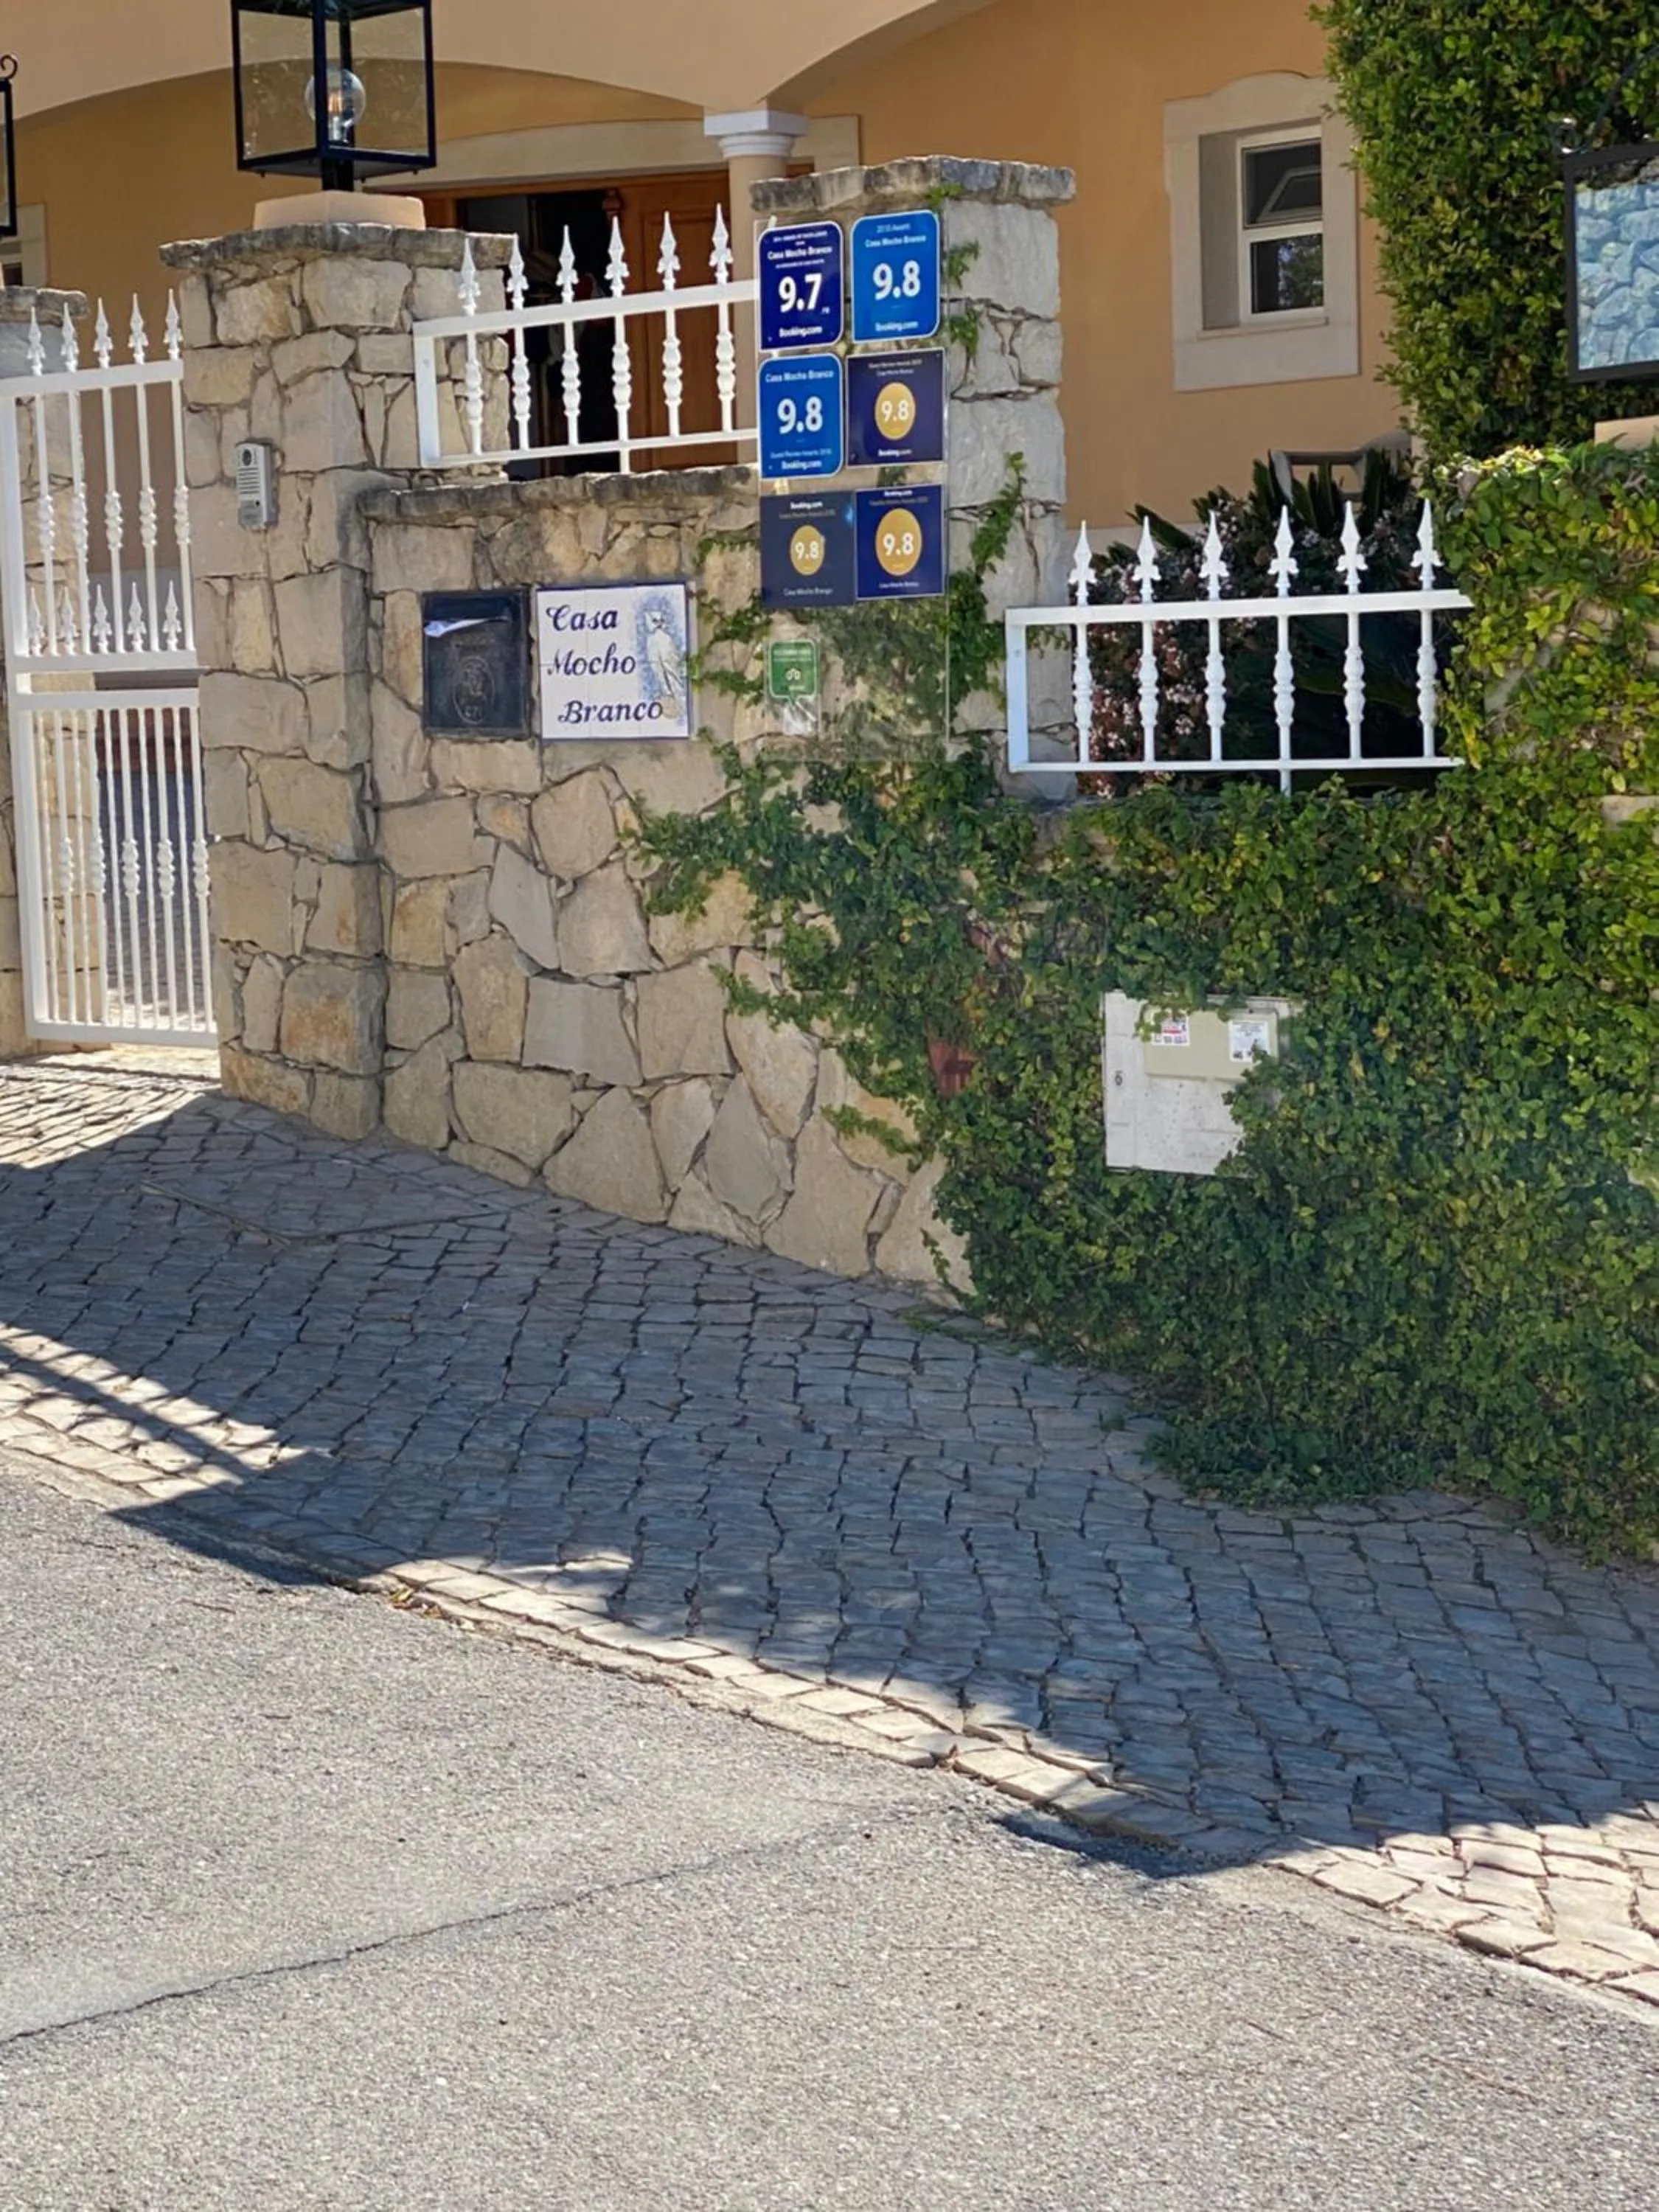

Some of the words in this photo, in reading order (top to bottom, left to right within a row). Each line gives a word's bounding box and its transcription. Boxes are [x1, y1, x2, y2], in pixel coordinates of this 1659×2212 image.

[872, 260, 921, 301] 9.8
[778, 273, 823, 313] 9.7
[779, 326, 823, 338] Booking.com
[874, 321, 919, 331] Booking.com
[777, 396, 823, 434] 9.8
[881, 400, 909, 422] 9.8
[782, 459, 822, 470] Booking.com
[795, 540, 819, 560] 9.8
[882, 532, 914, 556] 9.8
[546, 605, 619, 631] Casa
[547, 641, 636, 676] Mocho
[557, 700, 663, 724] Branco
